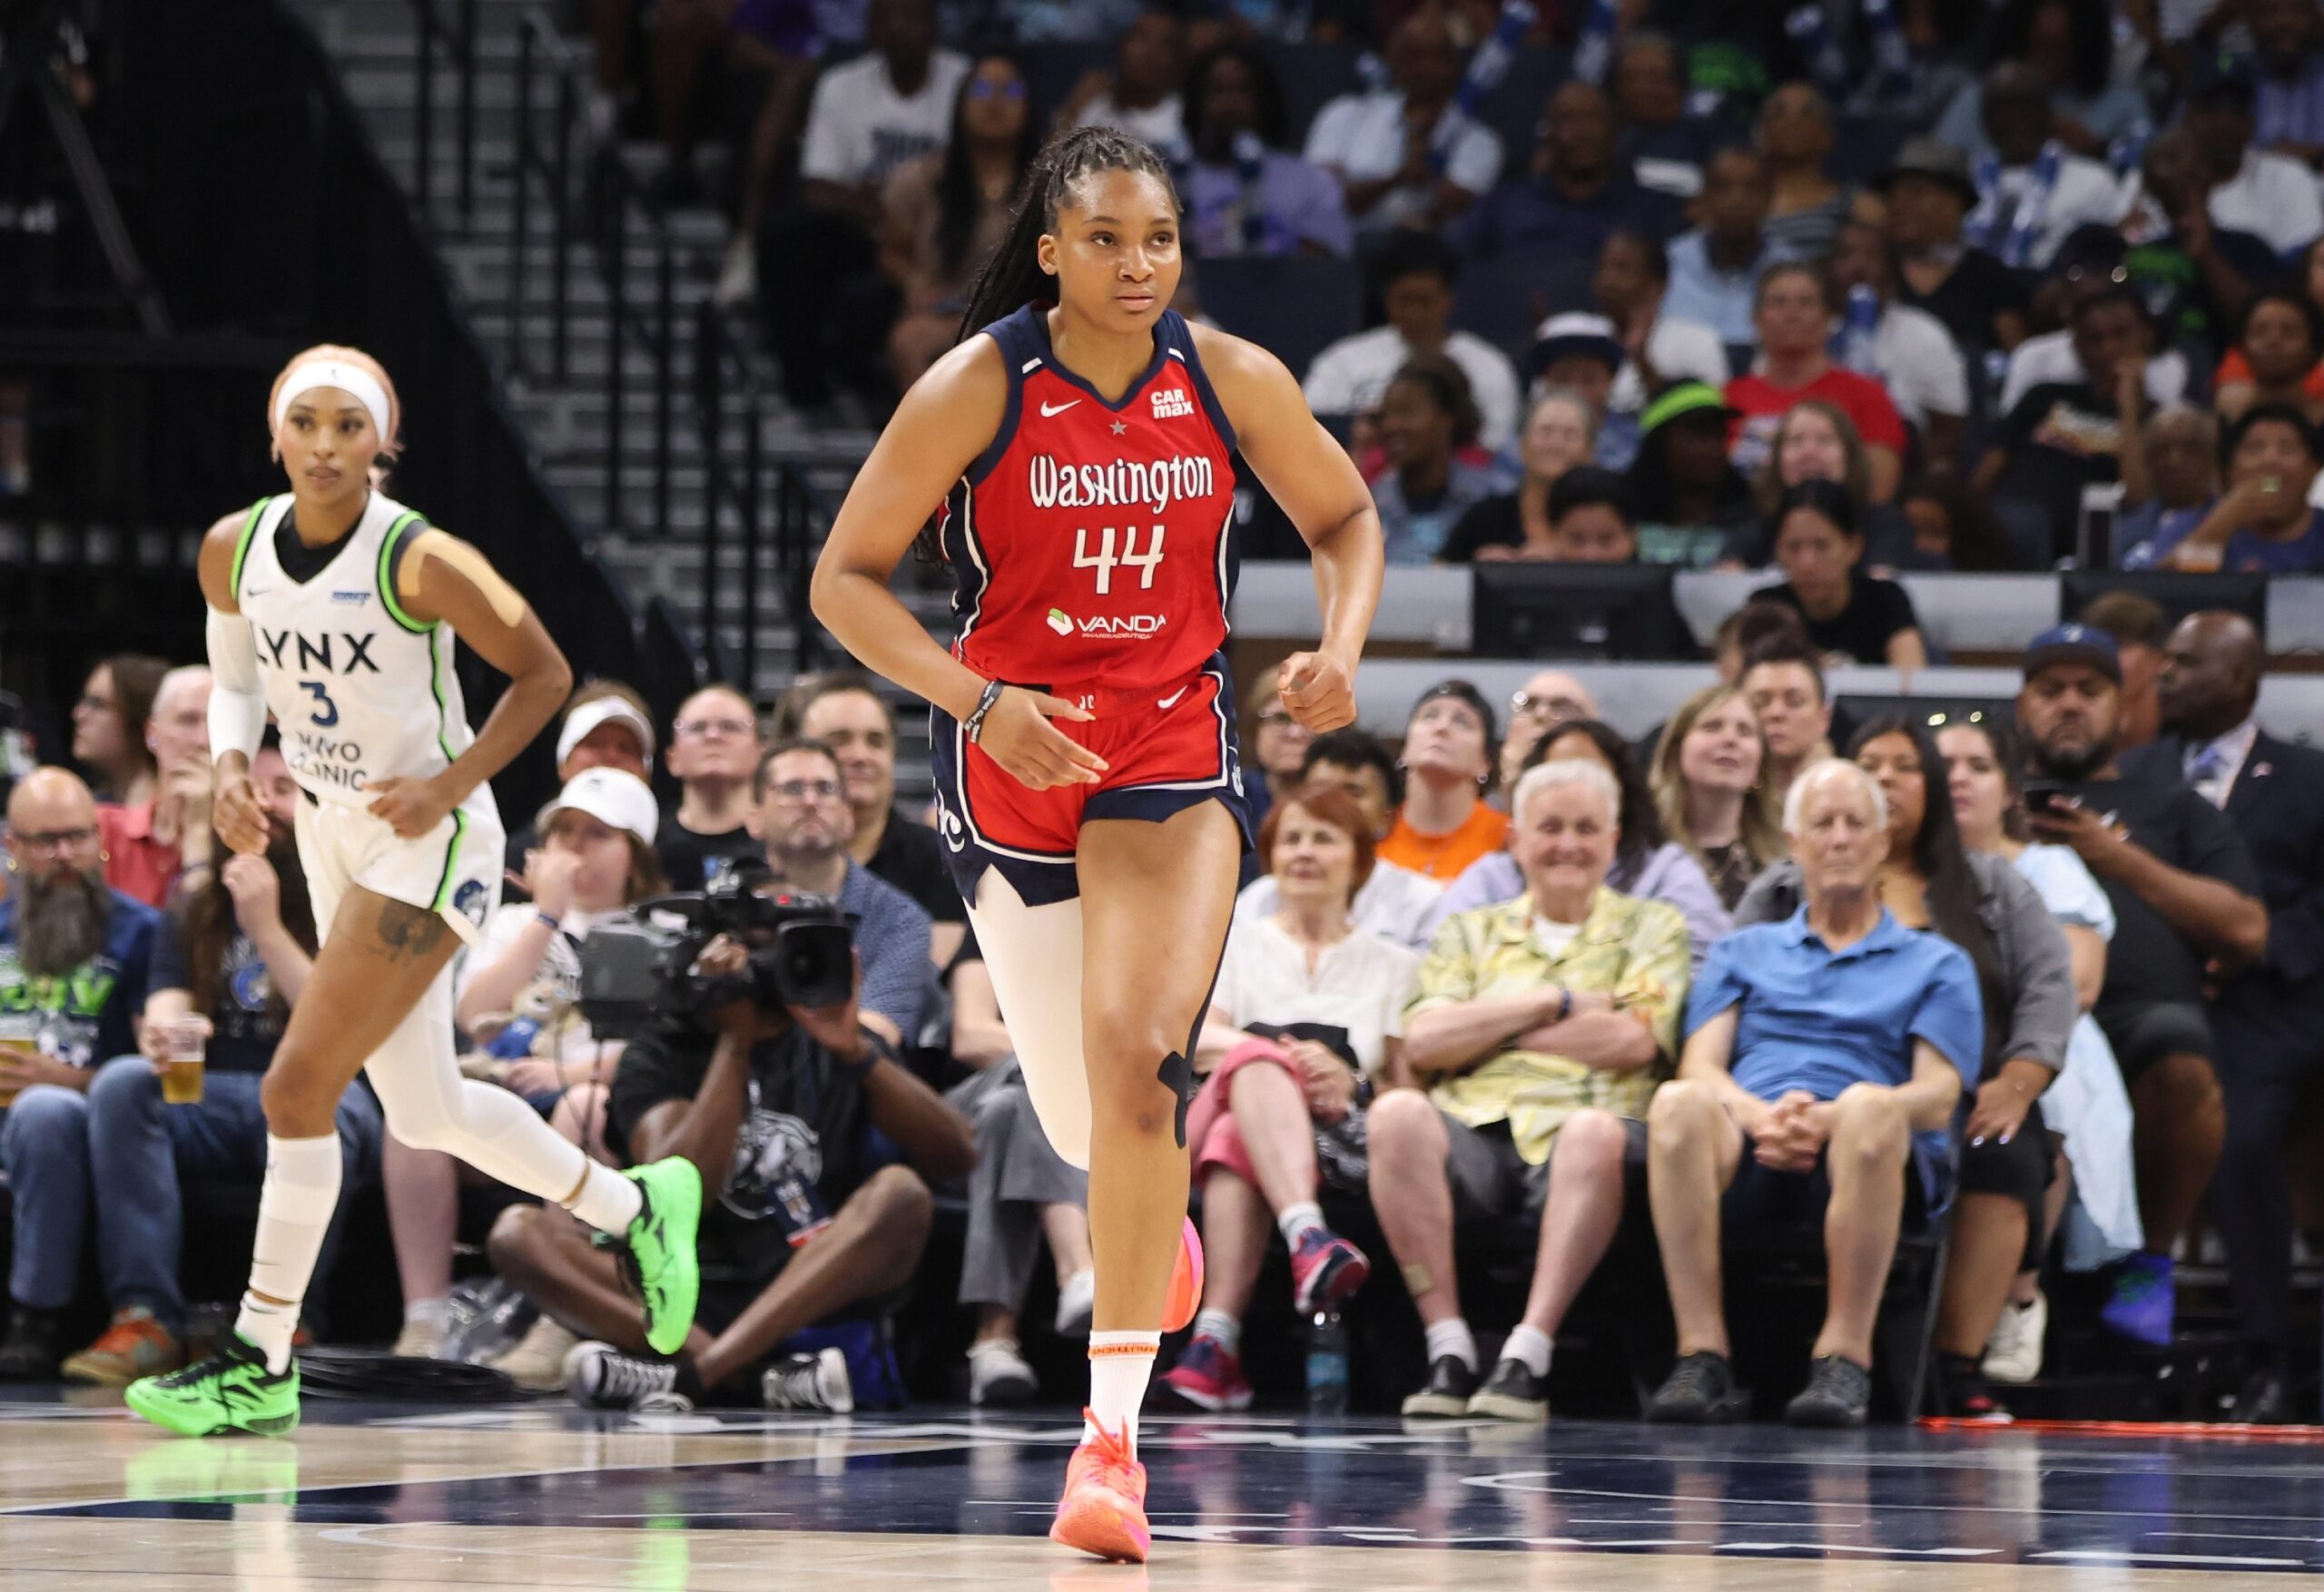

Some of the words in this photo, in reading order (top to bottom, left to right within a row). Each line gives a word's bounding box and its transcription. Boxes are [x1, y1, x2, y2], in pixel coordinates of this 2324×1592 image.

[1150, 388, 1185, 406] CAR
[1153, 400, 1195, 419] max
[1072, 524, 1166, 595] 44
[299, 681, 340, 727] 3
